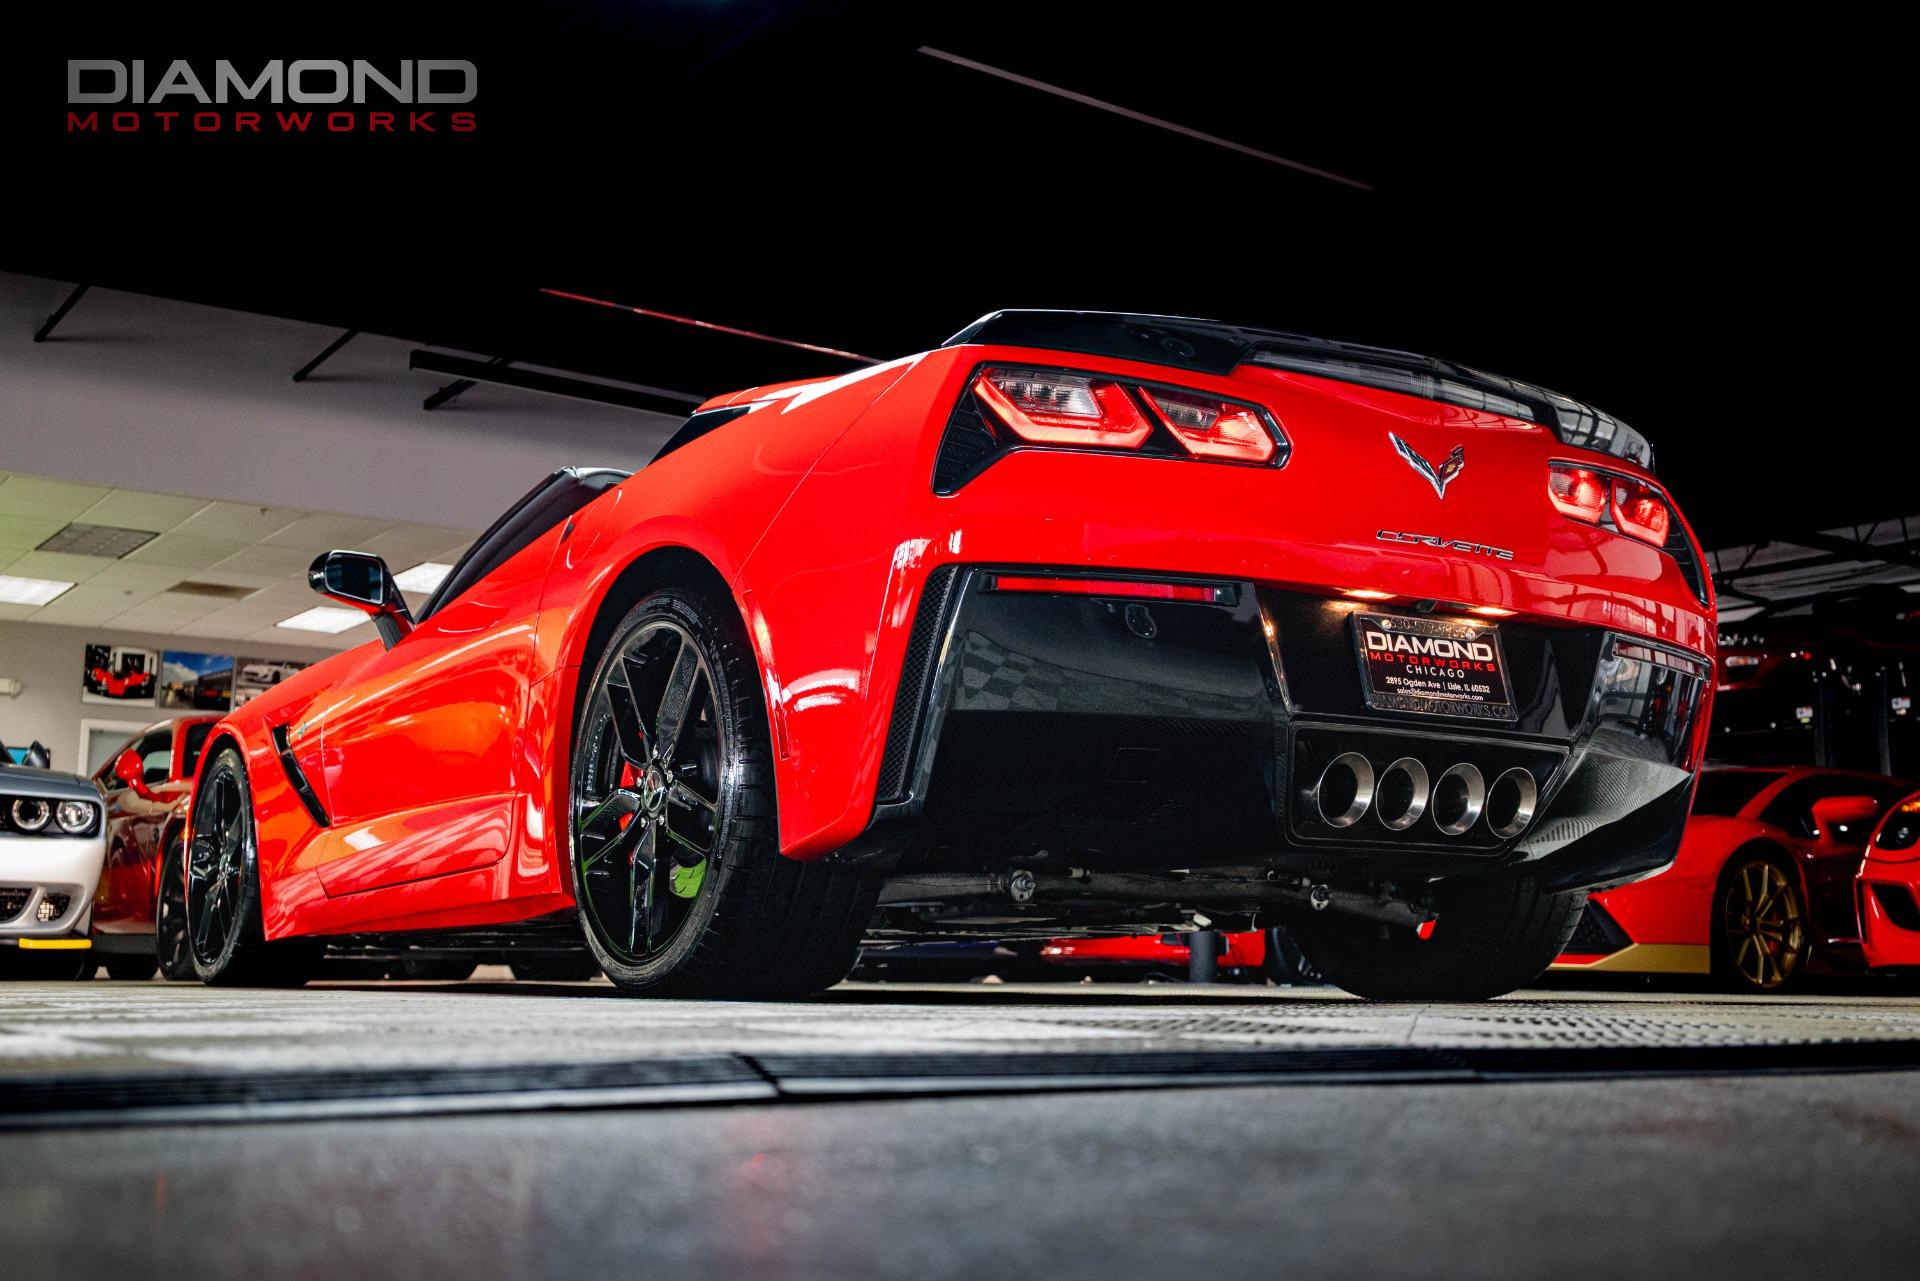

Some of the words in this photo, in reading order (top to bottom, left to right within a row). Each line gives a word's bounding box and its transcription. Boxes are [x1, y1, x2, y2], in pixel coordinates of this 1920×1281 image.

[1376, 529, 1515, 561] CORVETTE
[1366, 631, 1493, 662] DIAMOND
[1370, 652, 1496, 672] MOTORWORKS
[1406, 664, 1465, 679] CHICAGO
[1385, 676, 1402, 685] 2895
[1403, 678, 1427, 688] Ogden
[1427, 681, 1441, 689] Ave
[1471, 684, 1490, 693] 60532
